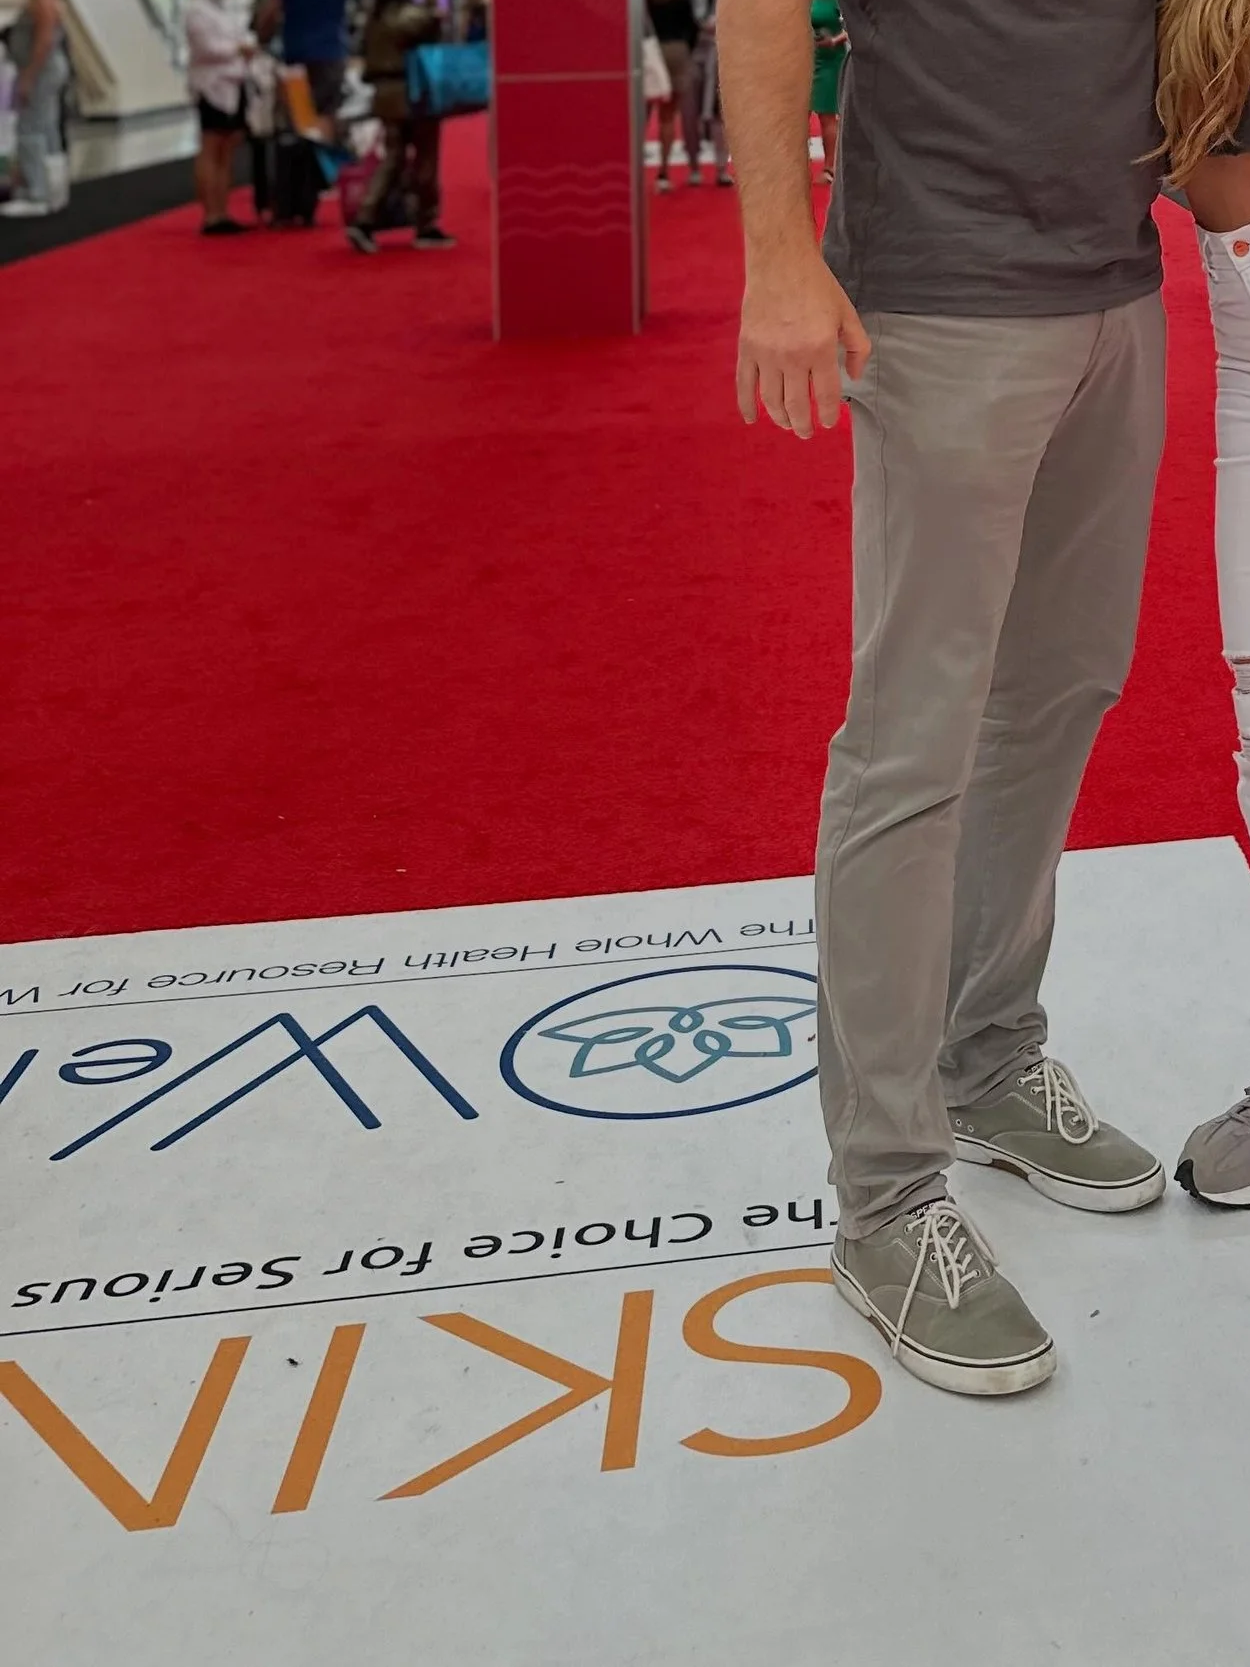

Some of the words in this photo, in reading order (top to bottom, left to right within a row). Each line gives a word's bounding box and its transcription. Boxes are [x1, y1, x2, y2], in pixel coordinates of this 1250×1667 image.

[405, 941, 556, 971] Health
[576, 927, 723, 955] Whole
[147, 955, 383, 987] Resource
[57, 978, 129, 996] for
[742, 1199, 838, 1230] he
[463, 1211, 714, 1259] Choice
[322, 1241, 431, 1277] for
[13, 1253, 301, 1308] Serious
